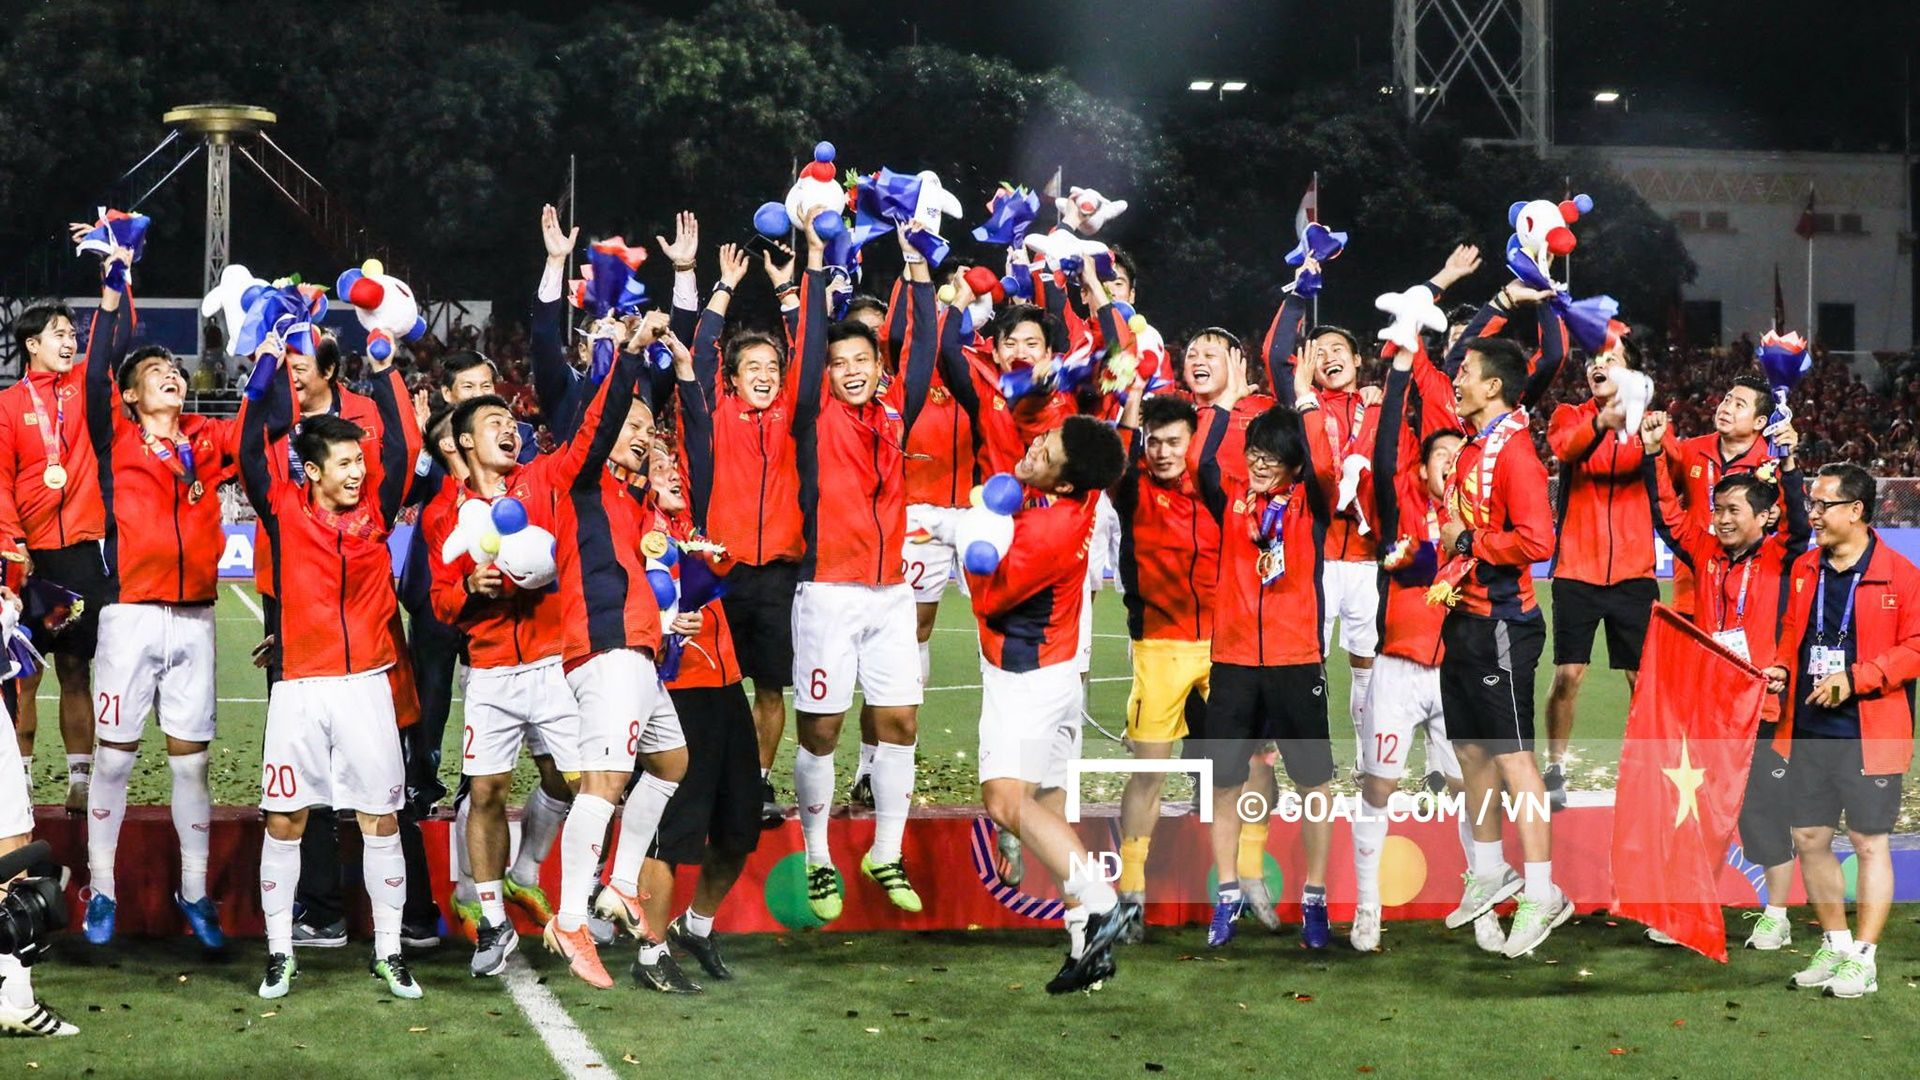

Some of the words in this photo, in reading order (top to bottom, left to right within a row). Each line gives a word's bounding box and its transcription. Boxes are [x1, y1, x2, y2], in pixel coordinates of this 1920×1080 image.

[810, 668, 827, 700] 6
[98, 691, 120, 726] 21
[1135, 698, 1142, 729] 1
[626, 720, 640, 756] 8
[1374, 733, 1398, 763] 12
[265, 763, 297, 798] 20
